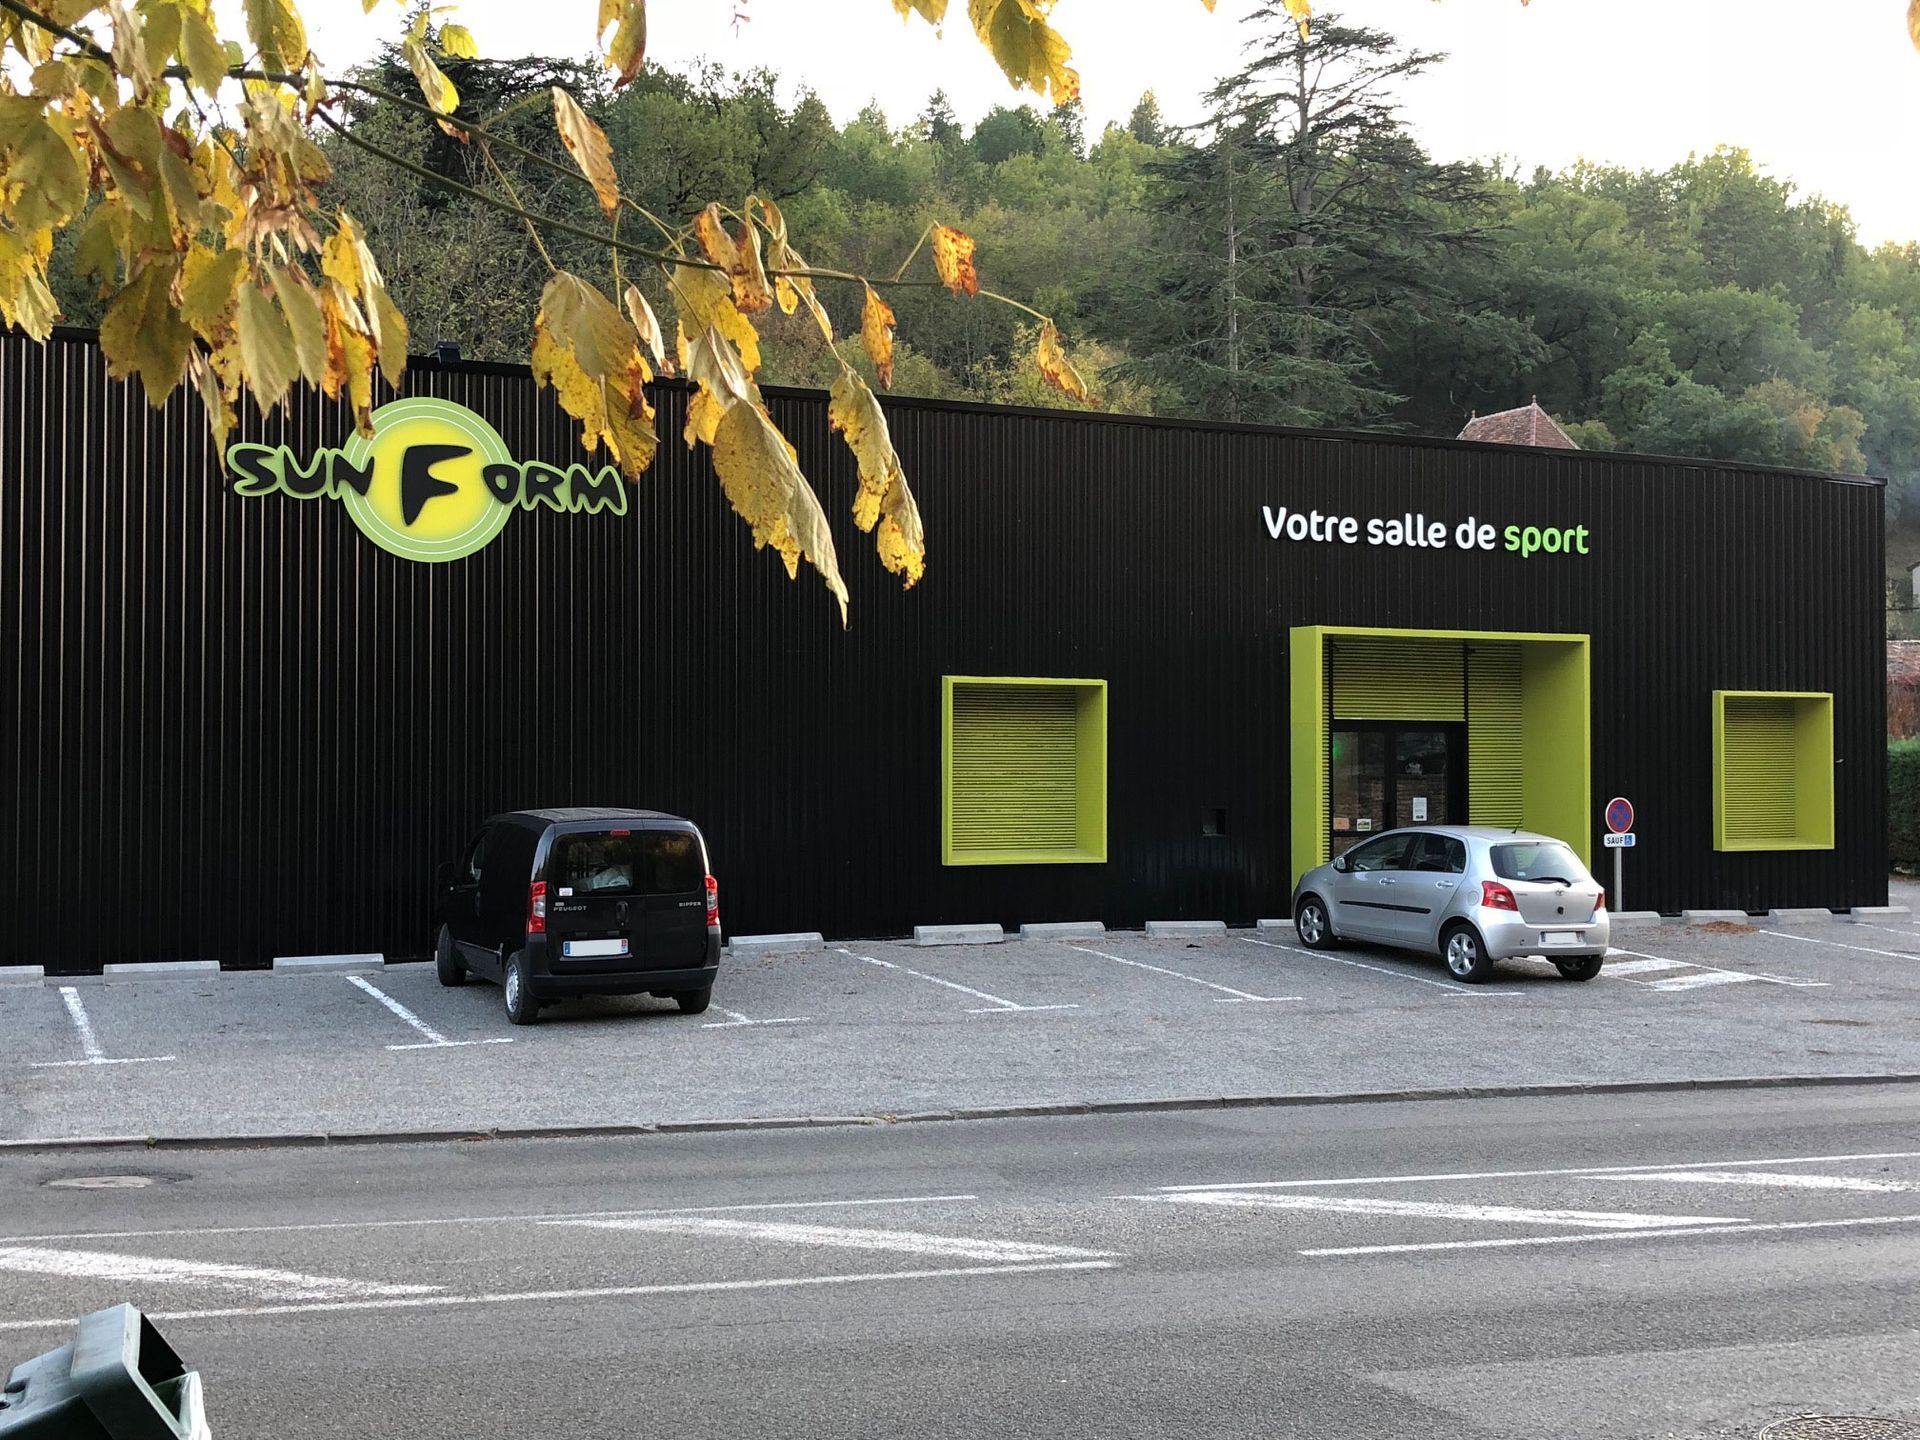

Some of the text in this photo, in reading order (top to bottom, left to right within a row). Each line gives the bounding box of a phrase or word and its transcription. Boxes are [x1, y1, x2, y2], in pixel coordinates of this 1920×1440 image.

[233, 447, 376, 498] SUN
[1262, 505, 1590, 559] Votre salle de sport
[1606, 836, 1624, 845] SAUF
